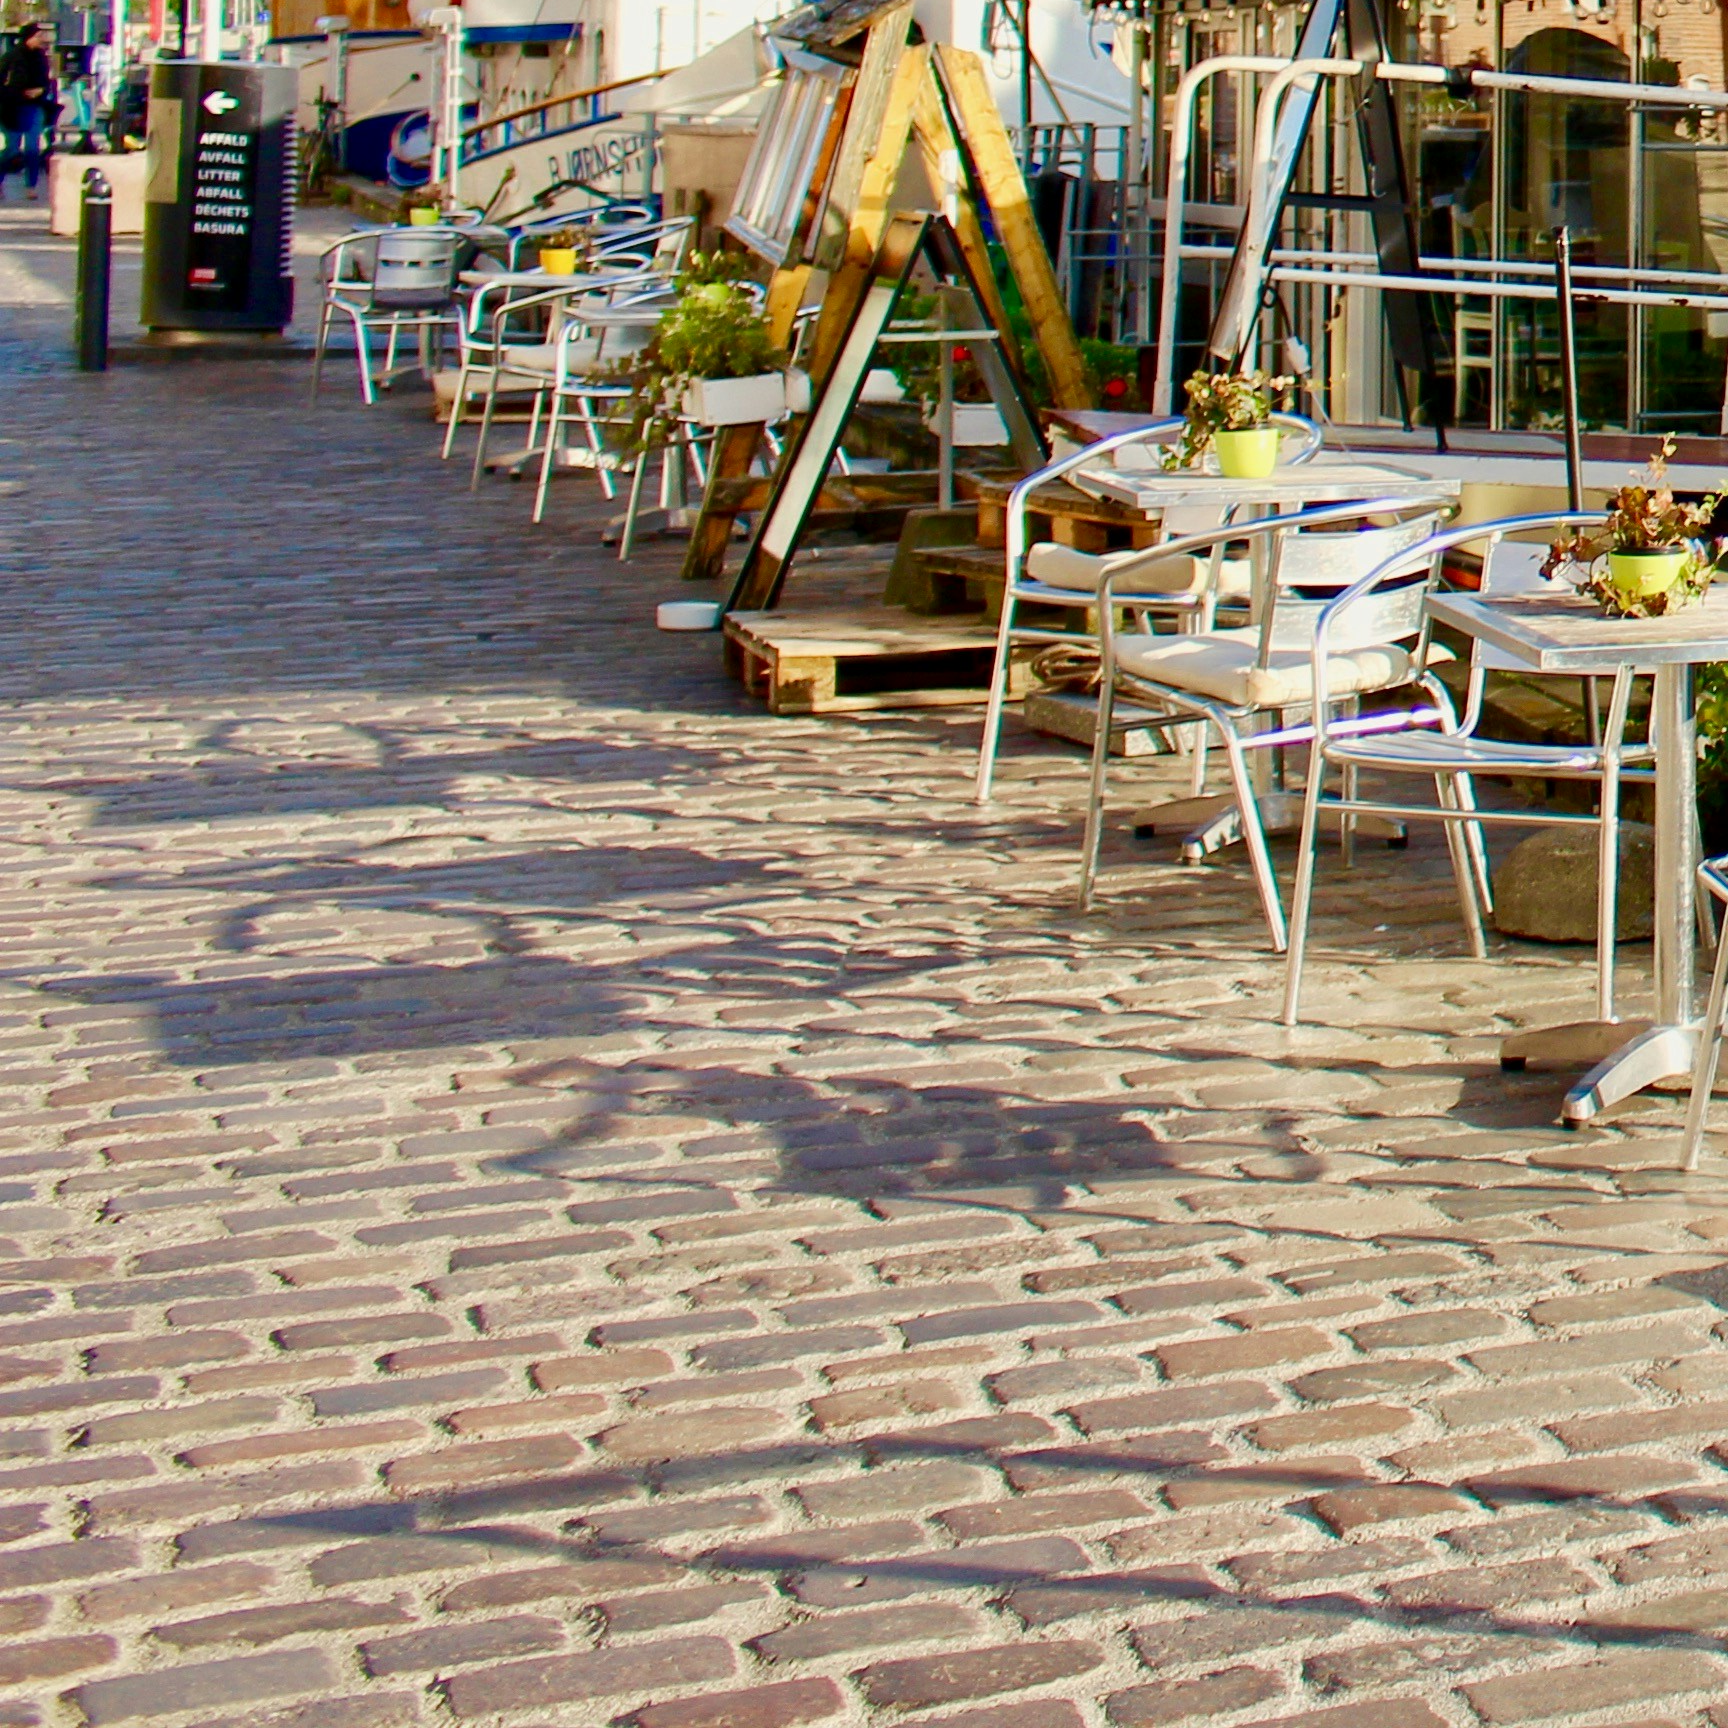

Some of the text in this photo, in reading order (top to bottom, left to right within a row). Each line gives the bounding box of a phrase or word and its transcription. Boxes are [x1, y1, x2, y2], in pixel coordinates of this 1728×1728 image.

[199, 132, 248, 147] AFFALD
[198, 150, 245, 165] AVFALL
[548, 135, 660, 184] BJØRNSH
[197, 168, 241, 183] LITTER
[196, 186, 243, 200] ABFALL
[193, 221, 245, 235] BASURA
